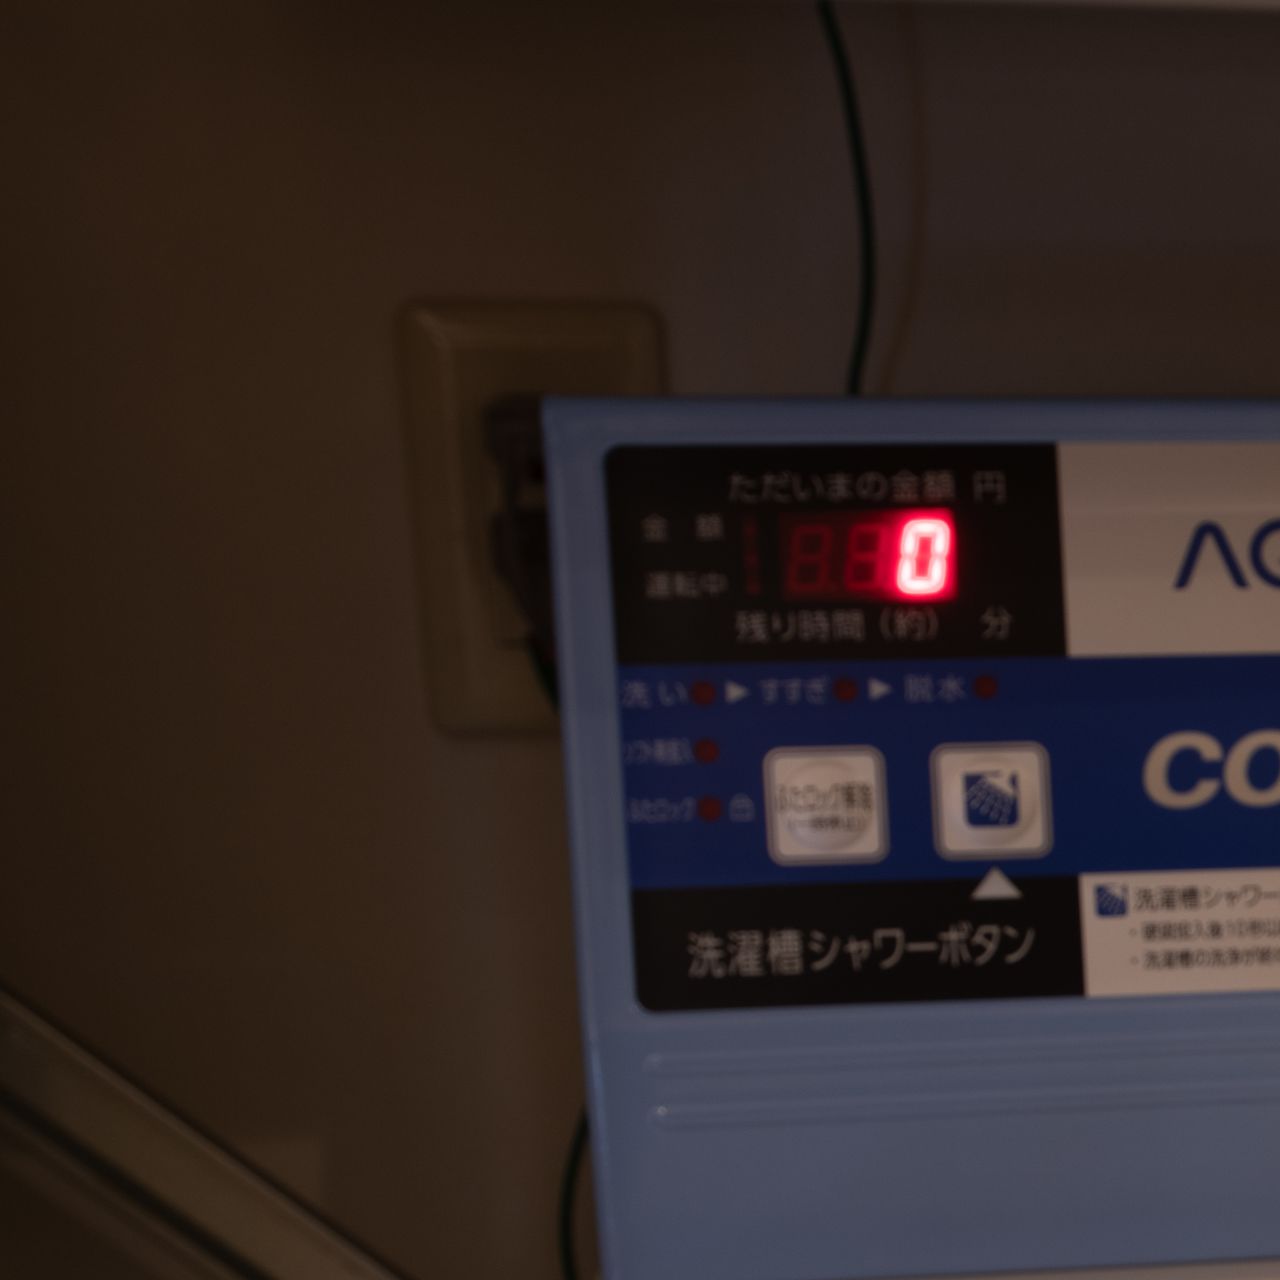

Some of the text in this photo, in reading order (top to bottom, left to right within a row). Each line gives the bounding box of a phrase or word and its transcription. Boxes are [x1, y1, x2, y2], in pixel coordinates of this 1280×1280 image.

[728, 470, 1007, 505] ただいまの金額 円
[981, 607, 1013, 639] 分
[686, 925, 1035, 979] 洗濯槽シャワーボタン
